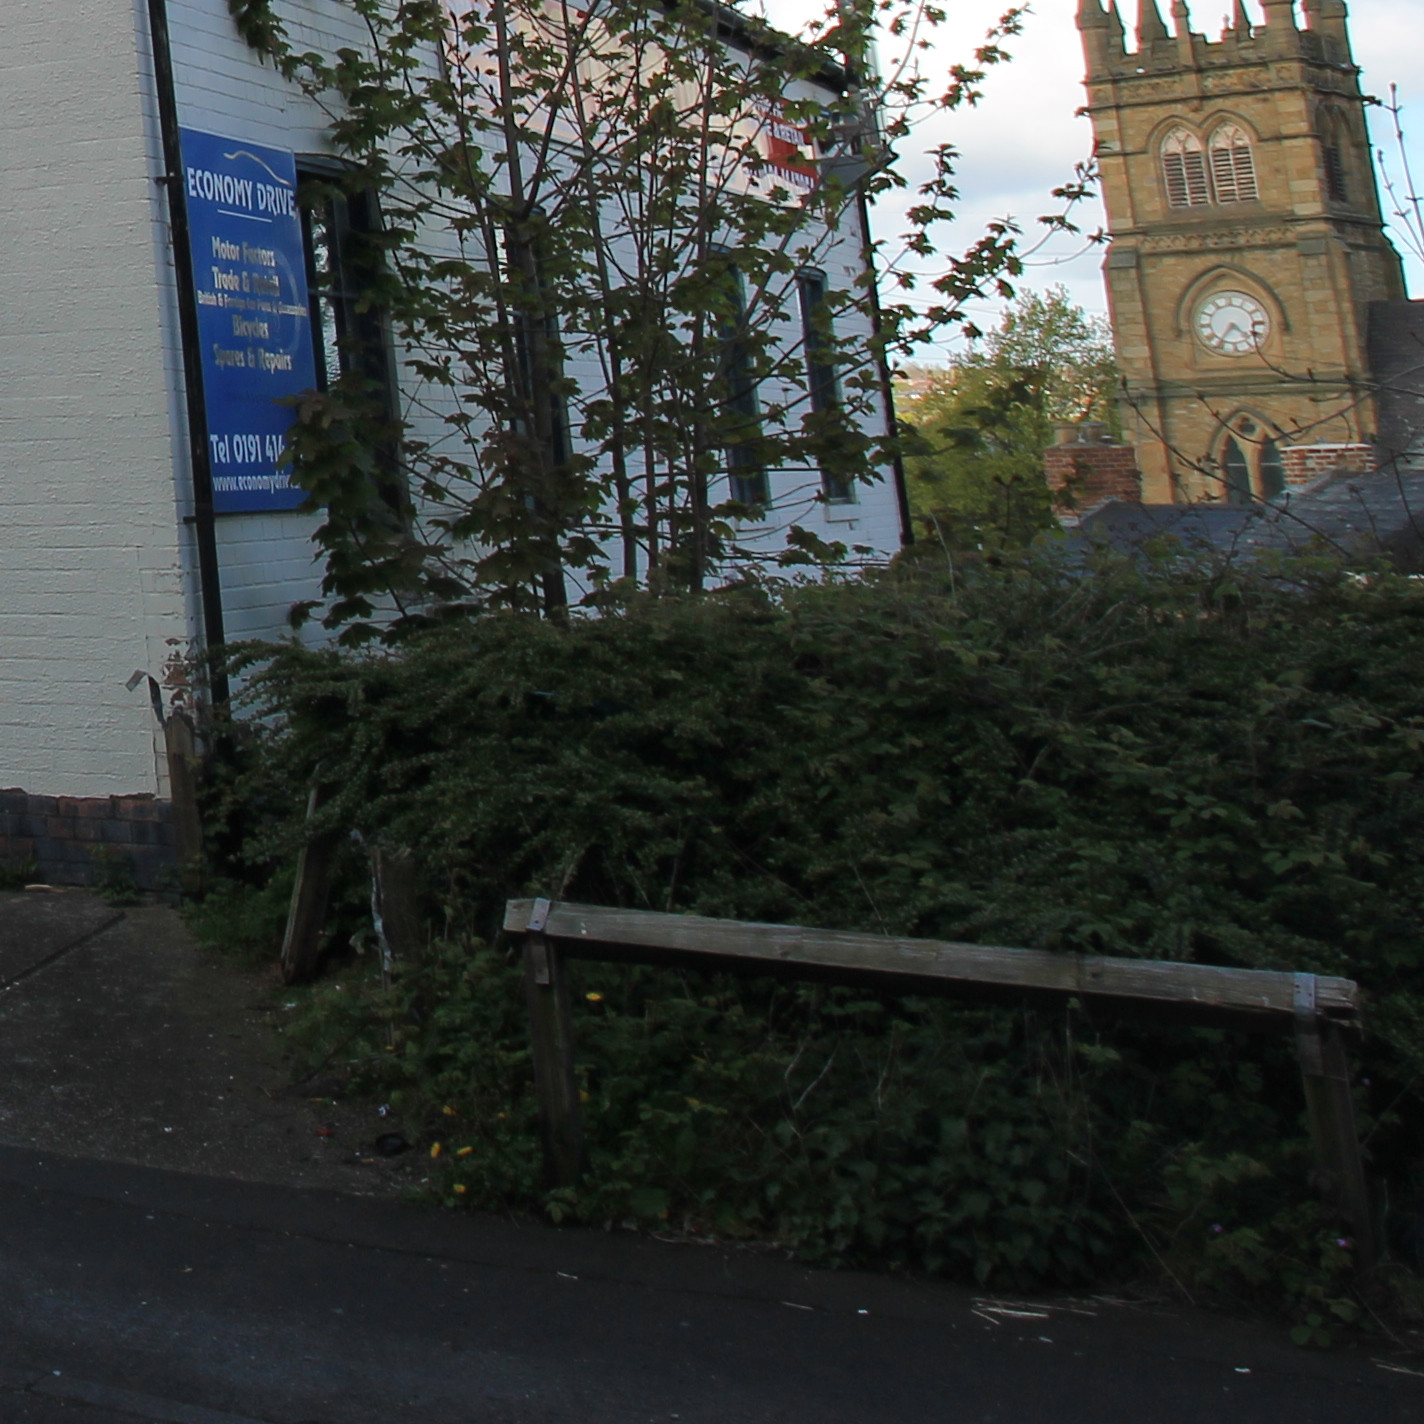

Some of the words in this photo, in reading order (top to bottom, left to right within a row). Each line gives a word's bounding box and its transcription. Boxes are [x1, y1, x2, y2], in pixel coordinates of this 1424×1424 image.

[186, 167, 253, 211] ECONOMY
[256, 182, 297, 217] DRIVE
[212, 236, 240, 262] Motor
[242, 241, 275, 267] Factors
[212, 266, 240, 291] Trade
[233, 314, 269, 341] Bicycles
[213, 343, 245, 371] Spares
[258, 347, 292, 375] Repairs
[210, 434, 230, 464] Tel
[233, 434, 262, 464] 0191
[212, 470, 301, 494] www.economydriv
